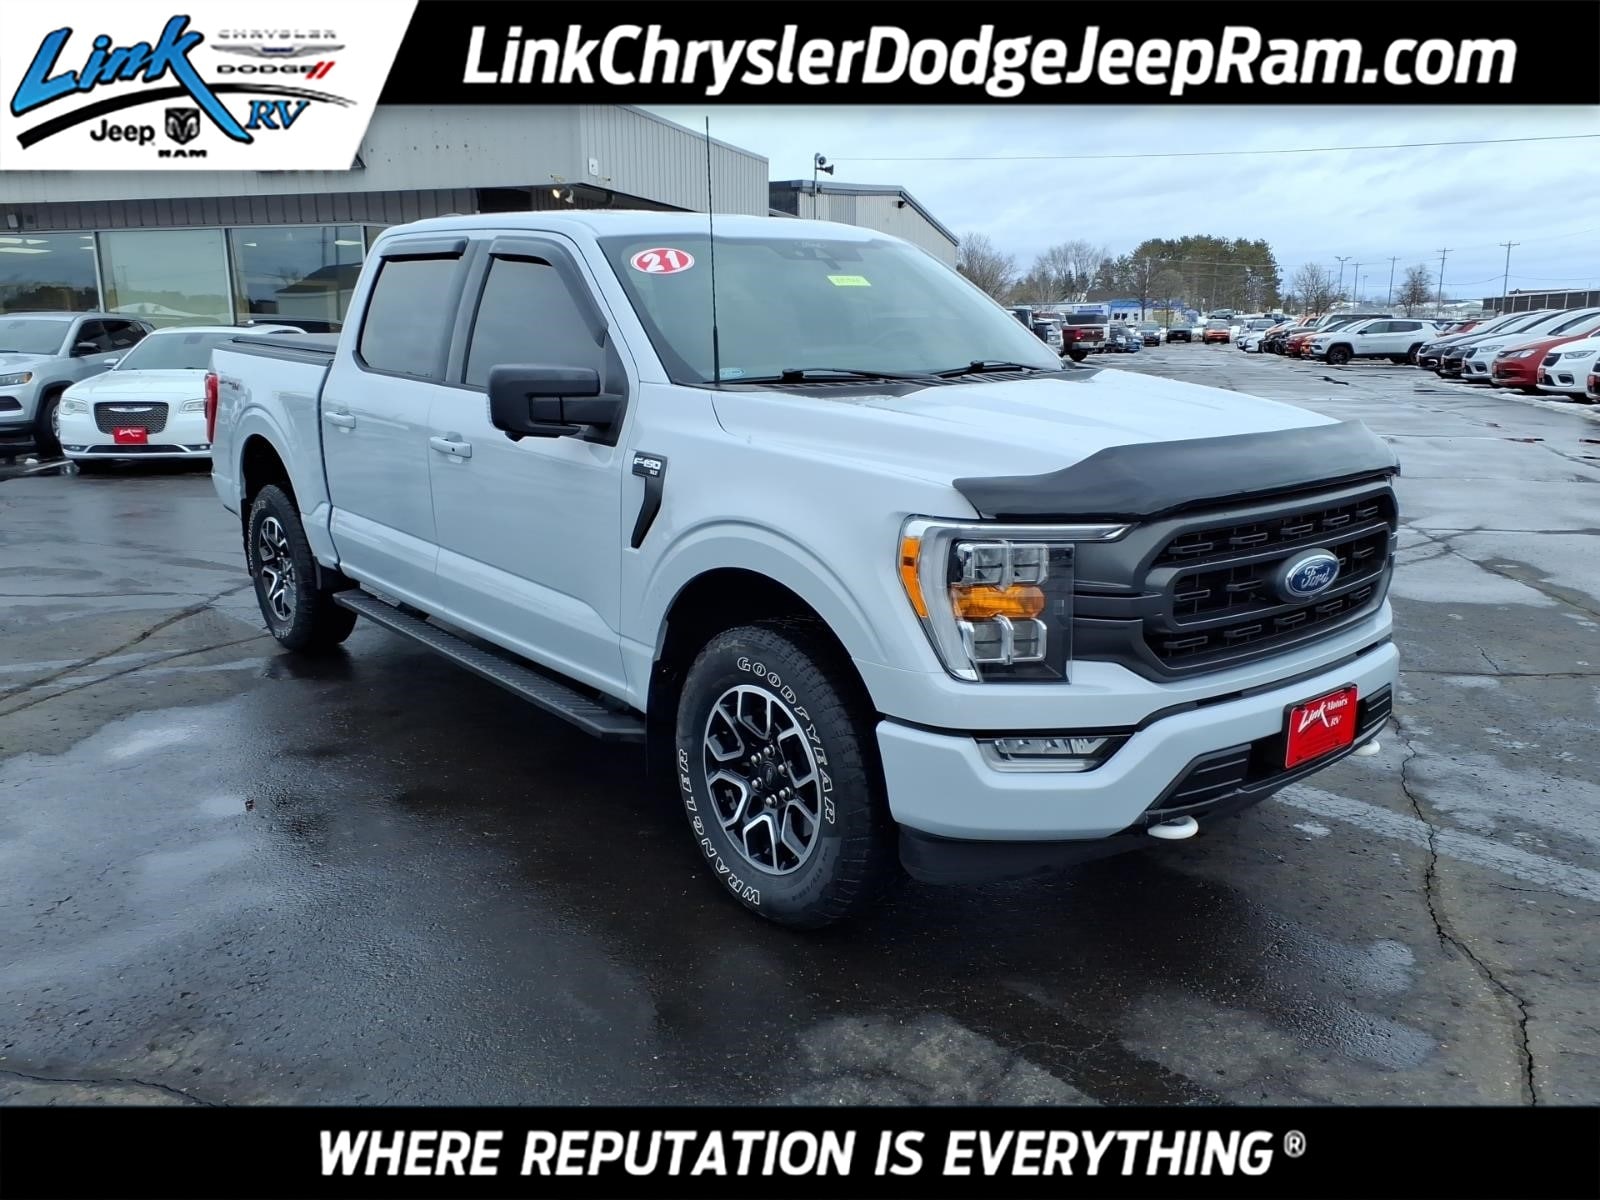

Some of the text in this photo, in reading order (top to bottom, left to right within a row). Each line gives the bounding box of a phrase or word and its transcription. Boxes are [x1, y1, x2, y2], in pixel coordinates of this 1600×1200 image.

[641, 250, 681, 272] 21
[633, 457, 662, 470] F-150
[1301, 564, 1330, 588] Ford
[1298, 701, 1330, 733] Link
[736, 656, 835, 825] GOODYEAR
[679, 748, 760, 905] WRANGLER
